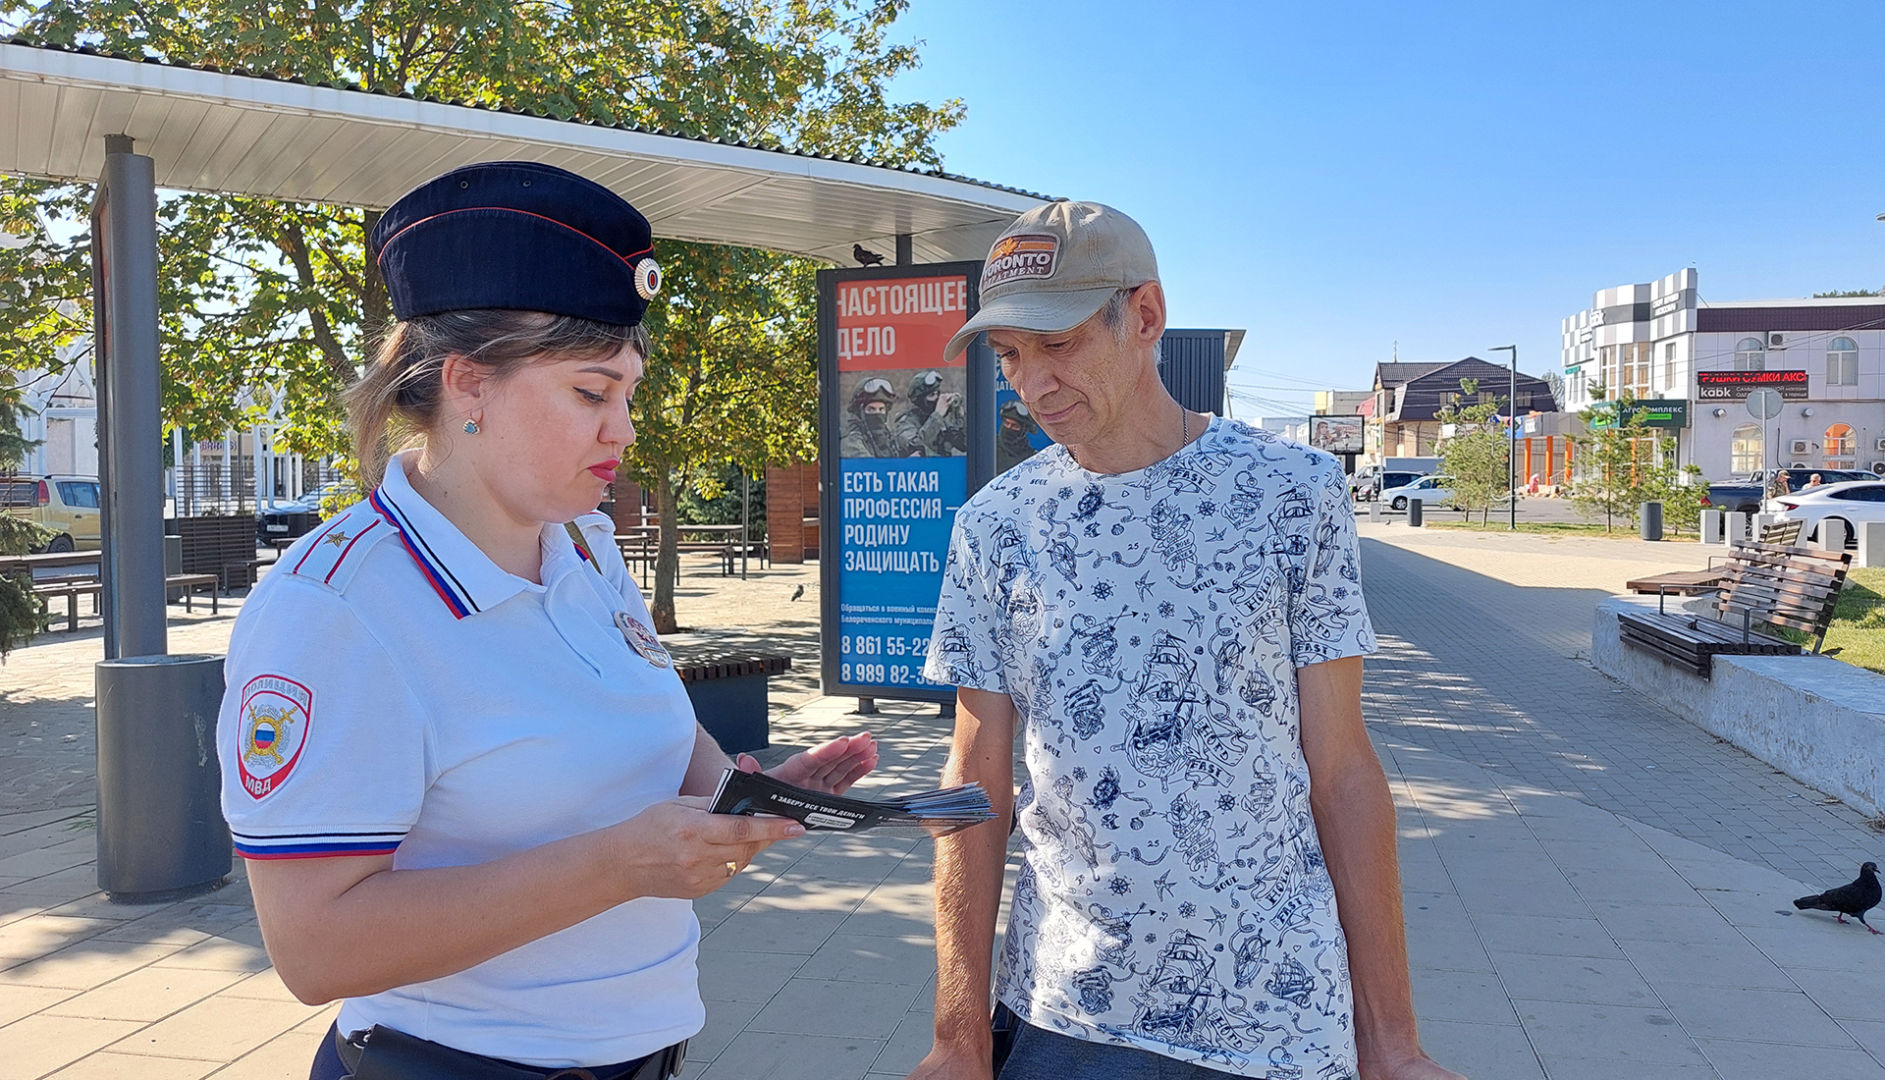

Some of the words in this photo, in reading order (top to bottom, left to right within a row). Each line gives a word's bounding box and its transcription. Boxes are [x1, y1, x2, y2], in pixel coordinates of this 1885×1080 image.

[837, 280, 967, 317] НАСТОЯЩЕЕ
[837, 326, 896, 360] ДЕЛО
[1700, 387, 1732, 397] kabk
[1622, 406, 1683, 414] АГРООМПЛЕКС
[843, 471, 883, 493] ЕСТЬ
[887, 471, 939, 493] ТАКАЯ
[844, 498, 942, 519] ПРОФЕССИЯ
[1023, 497, 1036, 506] 25
[844, 524, 910, 547] РОДИНУ
[1127, 542, 1140, 551] 25
[845, 551, 940, 574] ЗАЩИЩАТЬ
[1191, 578, 1218, 594] SOUL
[1244, 576, 1272, 612] HOLD
[1252, 608, 1278, 632] FAST
[841, 635, 851, 655] 8
[855, 635, 882, 656] 861
[886, 636, 931, 657] 55-22
[841, 662, 851, 682] 8
[855, 663, 885, 683] 989
[244, 679, 308, 707] ПОЛИЦИЯ
[1190, 760, 1222, 778] FAST
[245, 775, 272, 796] МВД
[777, 796, 806, 808] ЗАБЕРУ
[804, 803, 820, 812] ВСЕ
[836, 810, 866, 820] ДЕНЬГИ
[1147, 839, 1160, 848] 25
[1214, 875, 1240, 894] SOUL
[1265, 864, 1291, 906] HOLD
[1276, 897, 1303, 925] FAST
